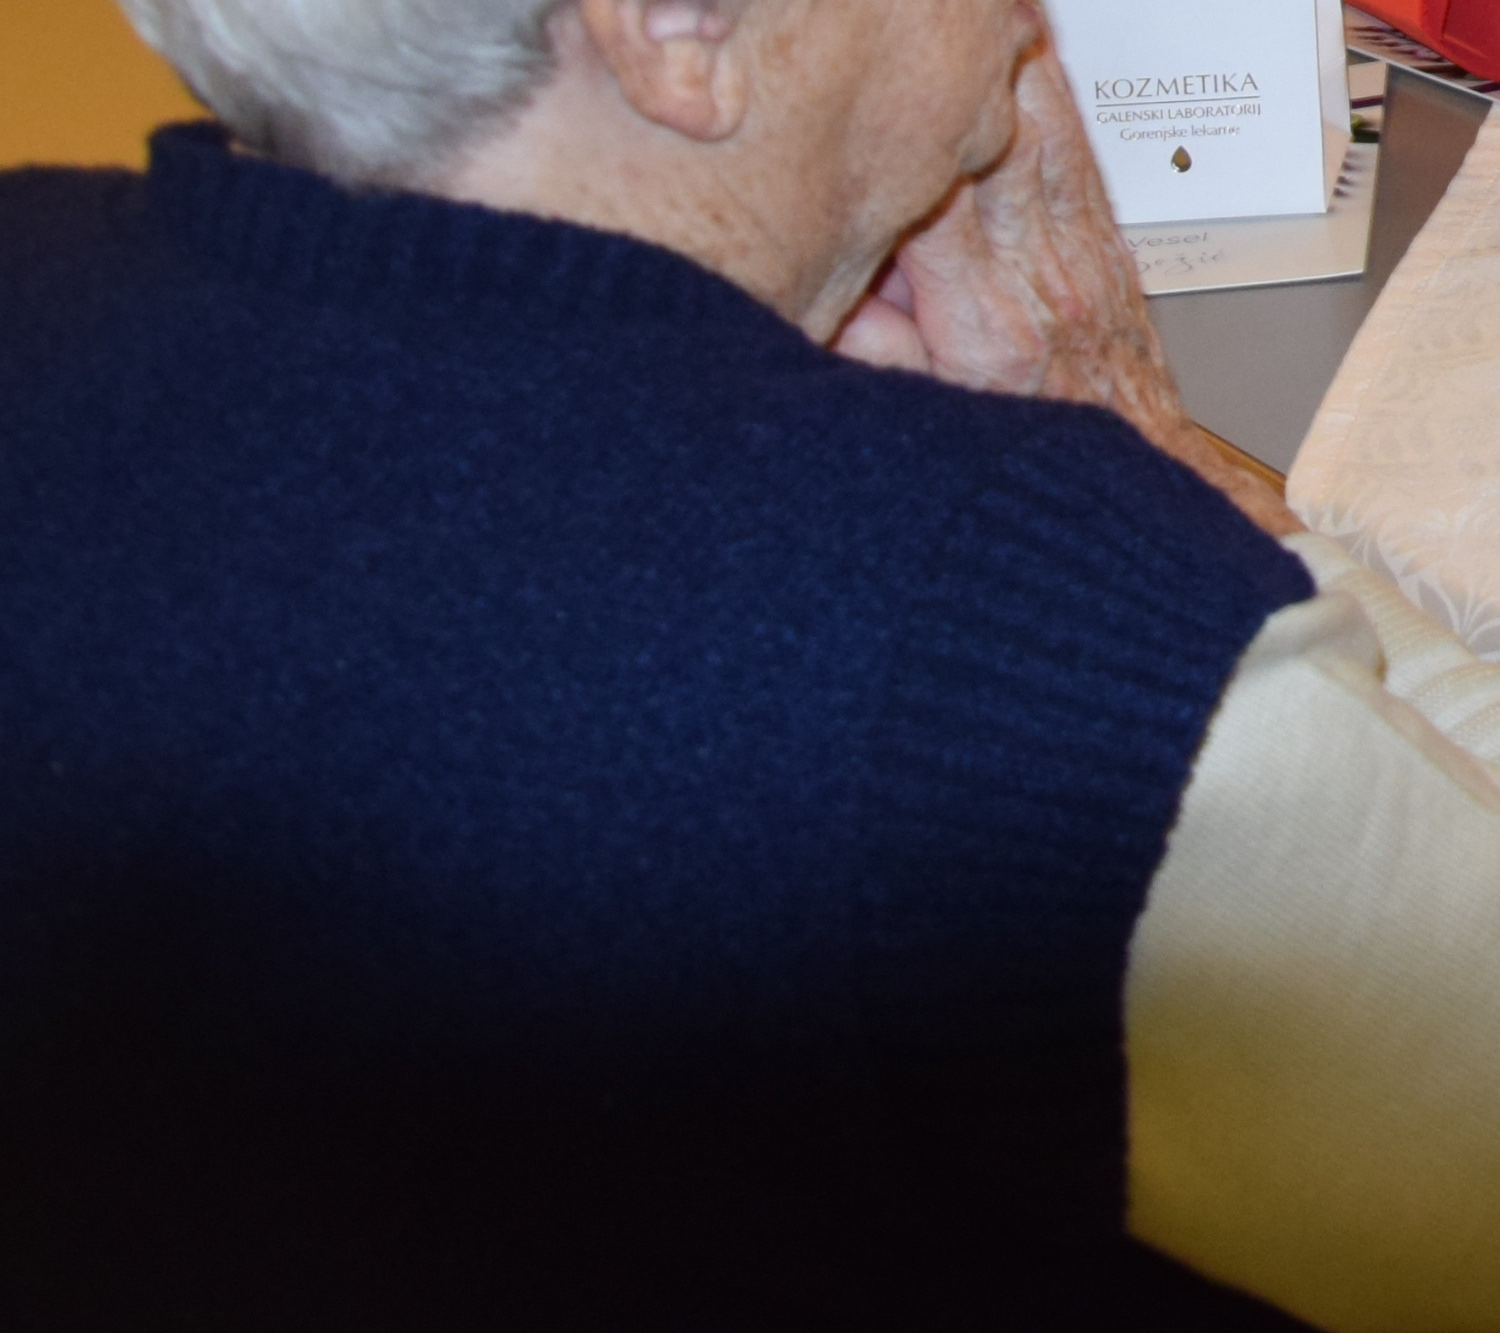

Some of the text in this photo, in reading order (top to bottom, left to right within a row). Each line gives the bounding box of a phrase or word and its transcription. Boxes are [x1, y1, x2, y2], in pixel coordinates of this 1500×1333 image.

[1094, 72, 1259, 100] KOZMETIKA
[1096, 103, 1261, 124] GALENSKI LABORATORIJ
[1119, 125, 1188, 142] Gorenjske
[1127, 231, 1208, 249] Vesel
